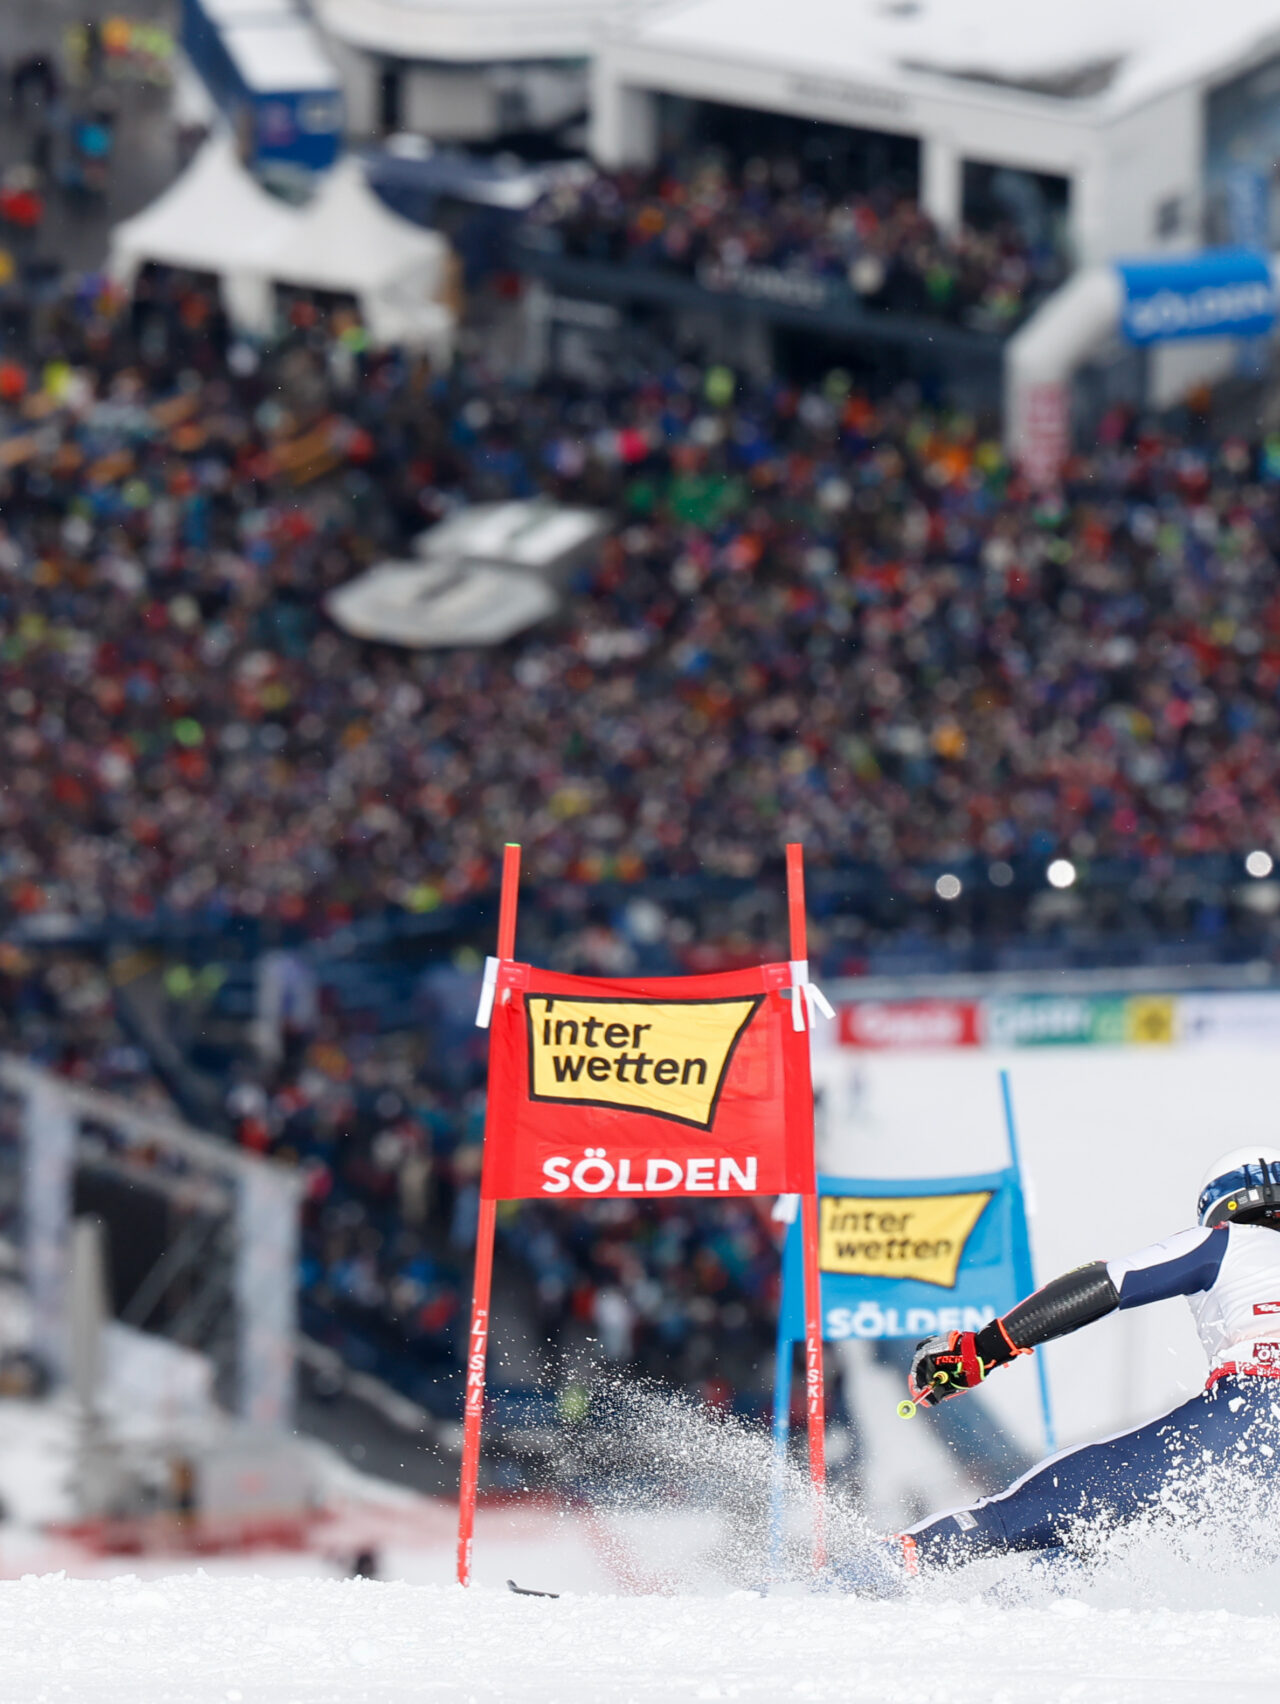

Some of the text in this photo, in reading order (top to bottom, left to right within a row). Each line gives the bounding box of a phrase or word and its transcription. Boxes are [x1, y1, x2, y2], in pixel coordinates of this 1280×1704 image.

[542, 1003, 652, 1049] inter
[553, 1053, 708, 1085] wetten
[542, 1147, 757, 1193] SÖLDEN
[830, 1200, 913, 1234] inter
[836, 1238, 954, 1260] wetten
[826, 1301, 996, 1338] SÖLDEN
[469, 1318, 487, 1404] LISKI
[807, 1338, 820, 1414] LISKI
